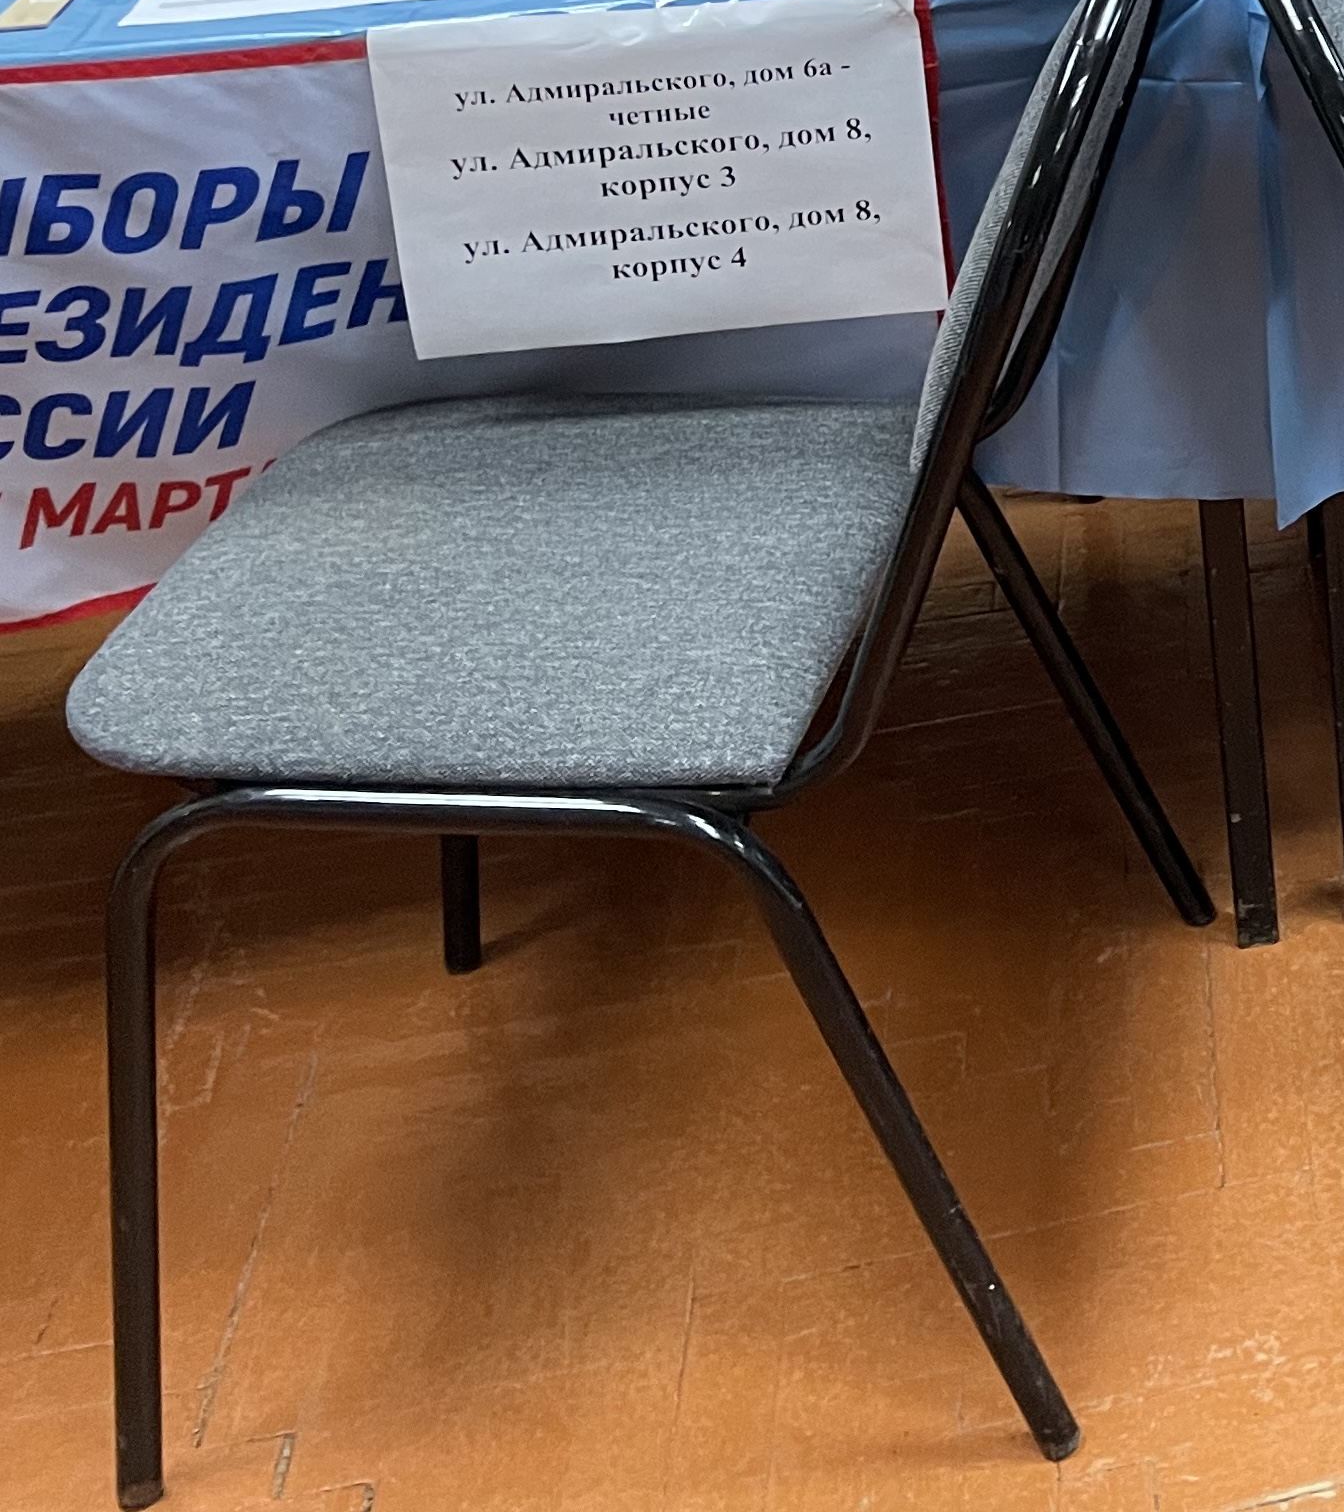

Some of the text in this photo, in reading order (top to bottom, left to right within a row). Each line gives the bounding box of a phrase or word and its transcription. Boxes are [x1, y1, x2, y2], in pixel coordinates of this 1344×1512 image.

[454, 90, 496, 112] ул.
[506, 71, 736, 104] Адмиральского,
[743, 65, 795, 88] дом
[802, 58, 833, 79] 6а
[608, 103, 712, 127] четные
[450, 117, 873, 180] ул. Адмиральского, дом 8,
[600, 165, 737, 201] корпус 3
[464, 199, 881, 264] ул. Адмиральского, дом 8,
[612, 246, 748, 282] корпус 4
[19, 458, 277, 550] МАРТ
